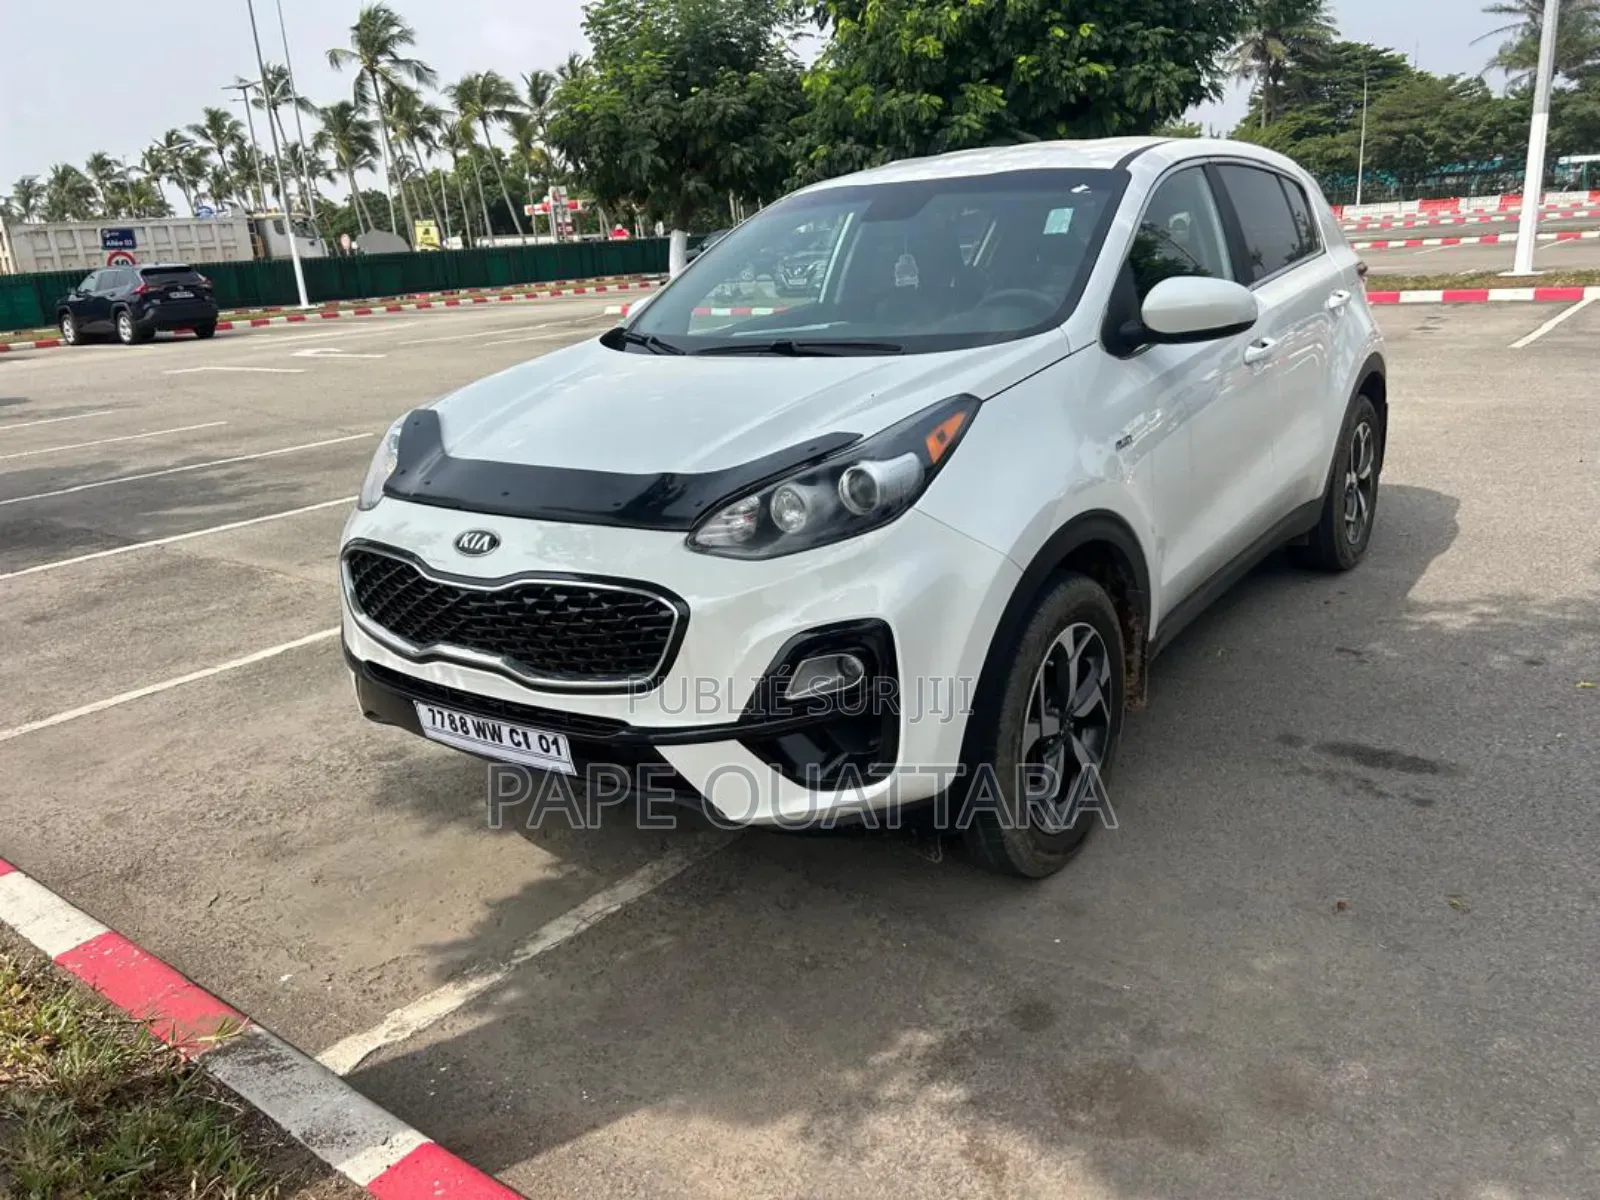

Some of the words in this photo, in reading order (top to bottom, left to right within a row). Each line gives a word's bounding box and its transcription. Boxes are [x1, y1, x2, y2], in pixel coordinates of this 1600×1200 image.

[458, 532, 491, 551] KIA
[428, 707, 470, 736] 7788
[471, 719, 503, 744] WW
[509, 728, 531, 750] CI
[538, 734, 562, 756] 01
